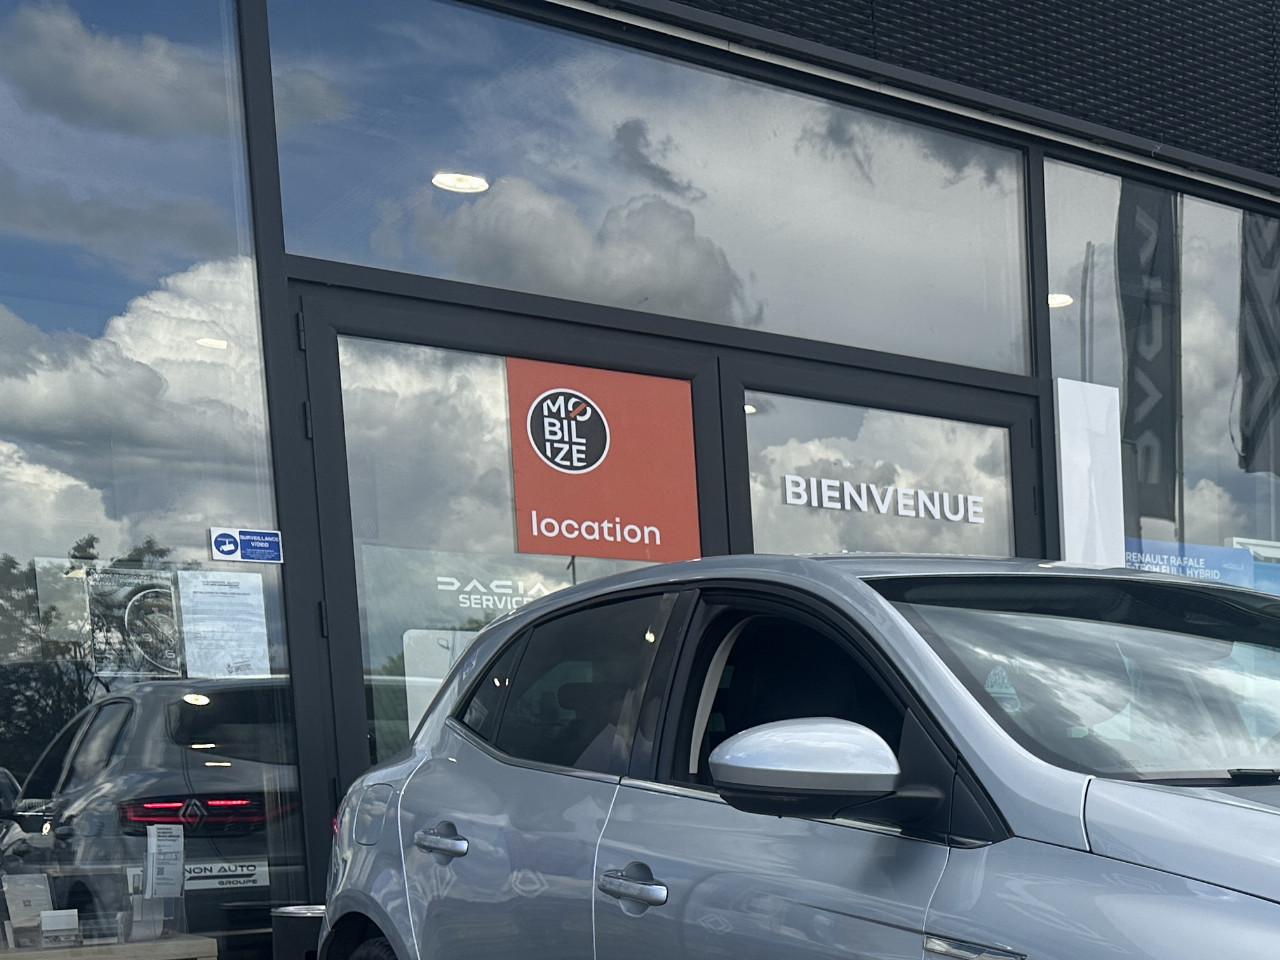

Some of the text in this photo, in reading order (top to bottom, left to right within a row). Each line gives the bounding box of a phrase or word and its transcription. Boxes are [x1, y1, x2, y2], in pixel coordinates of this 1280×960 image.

[543, 417, 587, 444] BIL
[545, 441, 588, 467] IZE
[784, 474, 986, 524] BIENVENUE
[531, 510, 661, 545] location
[240, 534, 279, 542] SURVEILLANCE
[1125, 552, 1206, 568] RENAULT RAFALE
[1186, 567, 1221, 580] HYBRID
[436, 576, 551, 595] DACIA
[218, 864, 257, 873] AUTO
[218, 878, 258, 886] GROUPE
